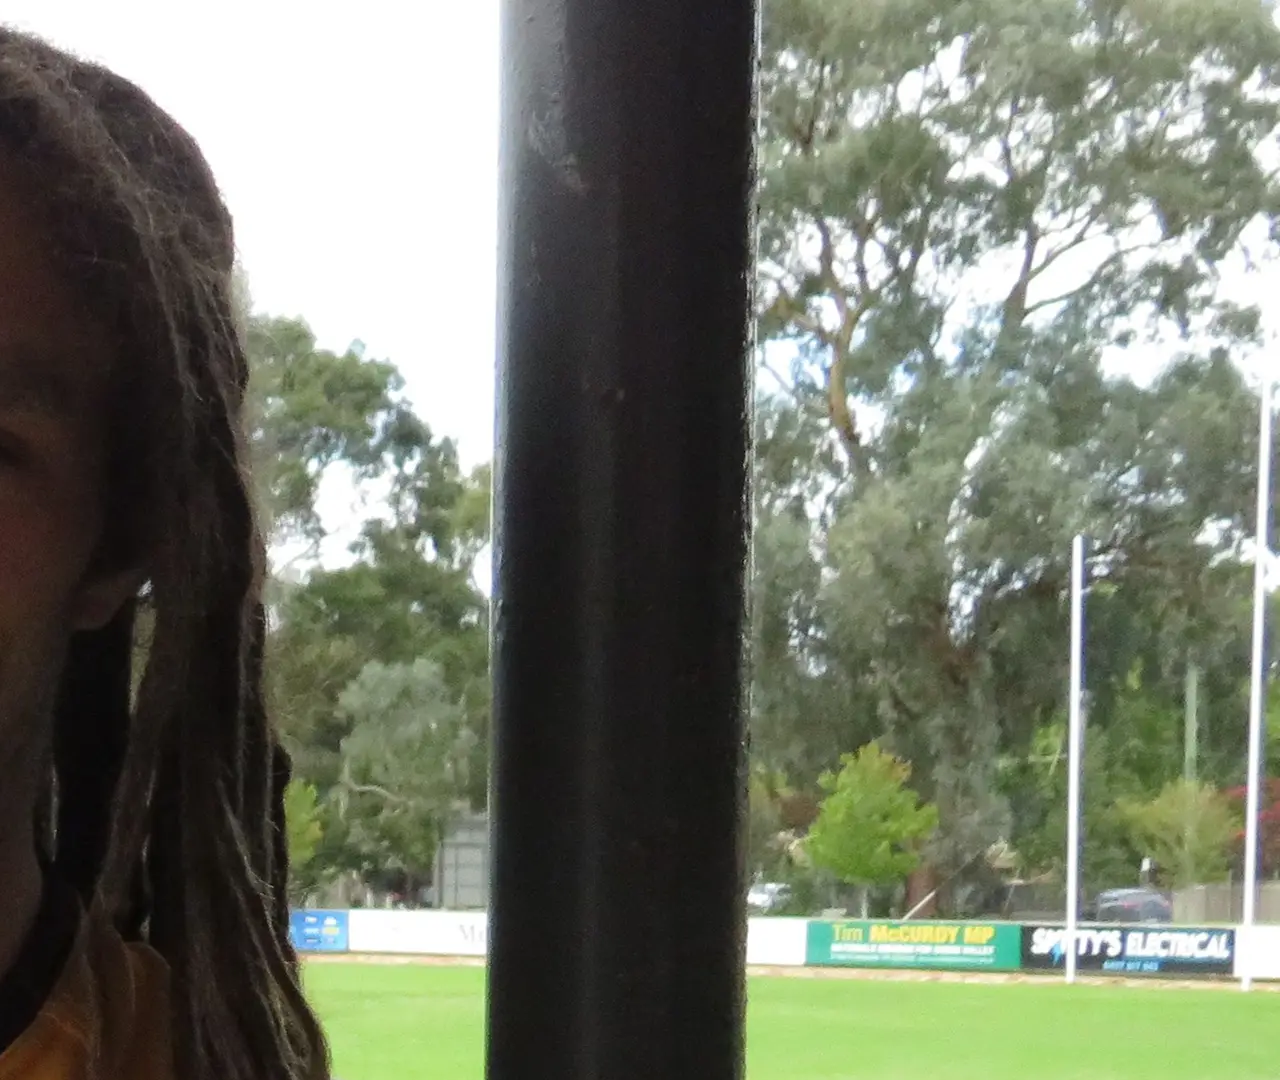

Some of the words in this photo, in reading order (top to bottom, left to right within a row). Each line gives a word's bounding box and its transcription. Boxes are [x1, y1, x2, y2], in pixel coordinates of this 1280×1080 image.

[832, 924, 864, 942] Tim
[963, 926, 996, 945] MP
[1124, 931, 1231, 958] ELECTRICAL
